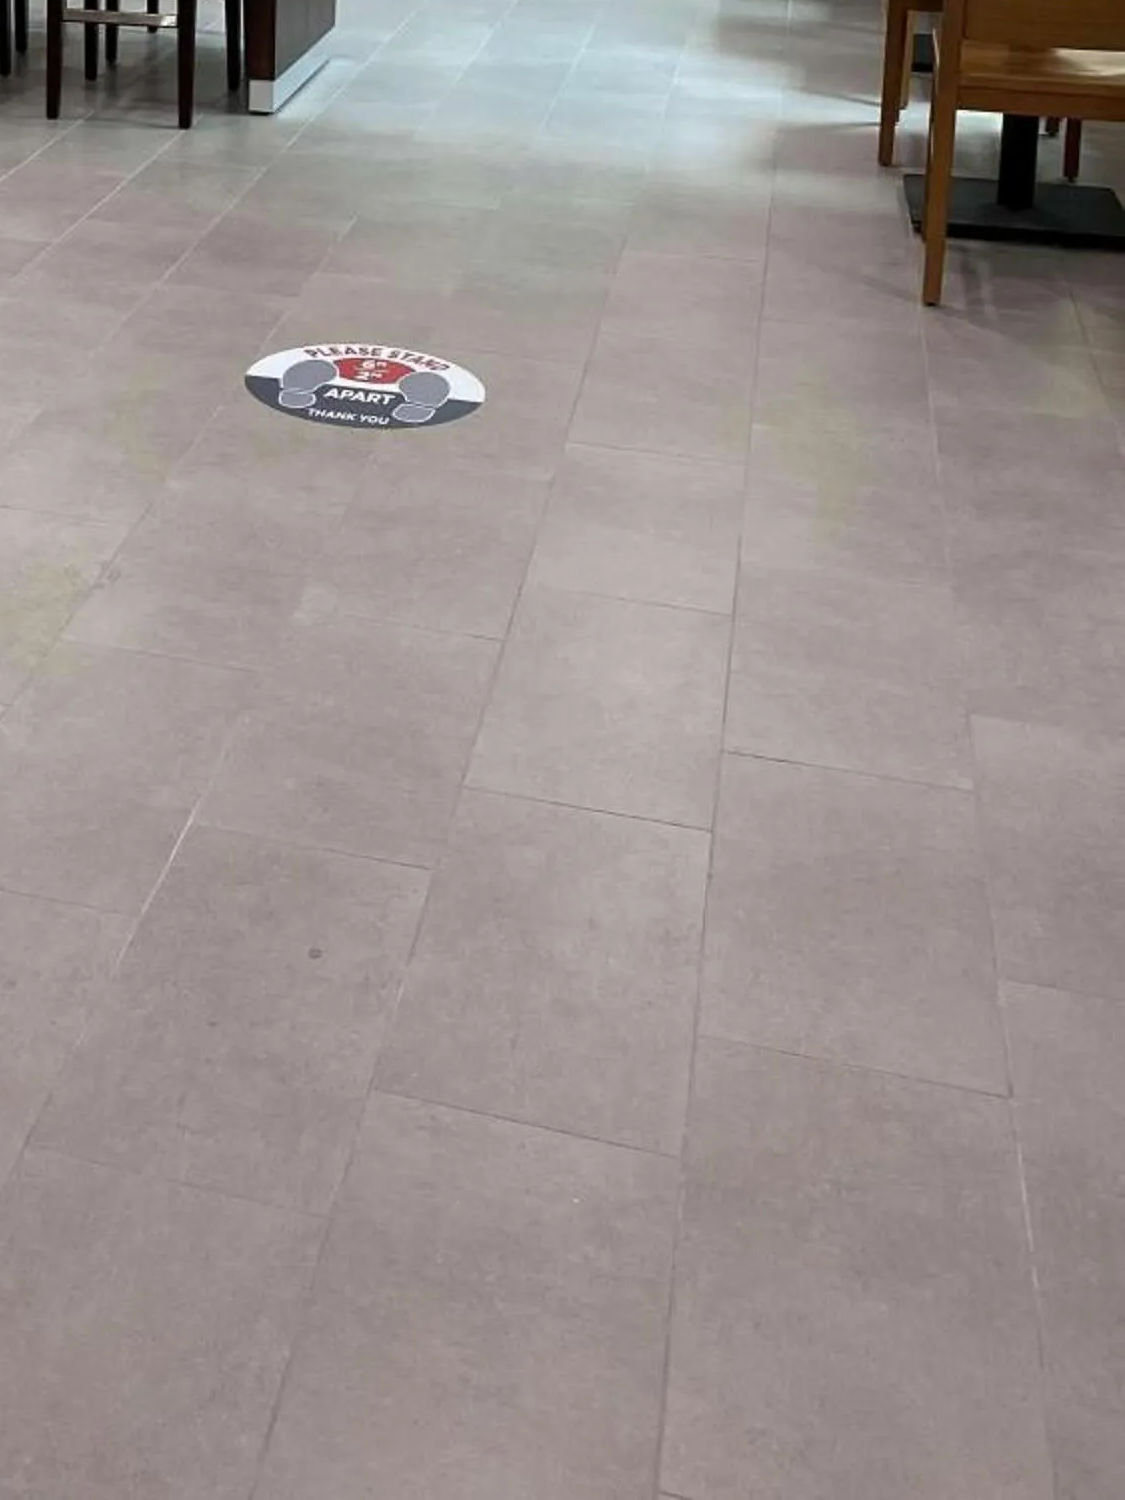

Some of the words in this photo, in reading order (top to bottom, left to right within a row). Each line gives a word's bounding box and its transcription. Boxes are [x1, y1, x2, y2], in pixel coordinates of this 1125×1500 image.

[303, 347, 383, 358] PLEASE
[387, 350, 451, 371] STAND
[323, 388, 396, 405] APART
[307, 408, 357, 421] THANK
[359, 414, 390, 425] YOU
